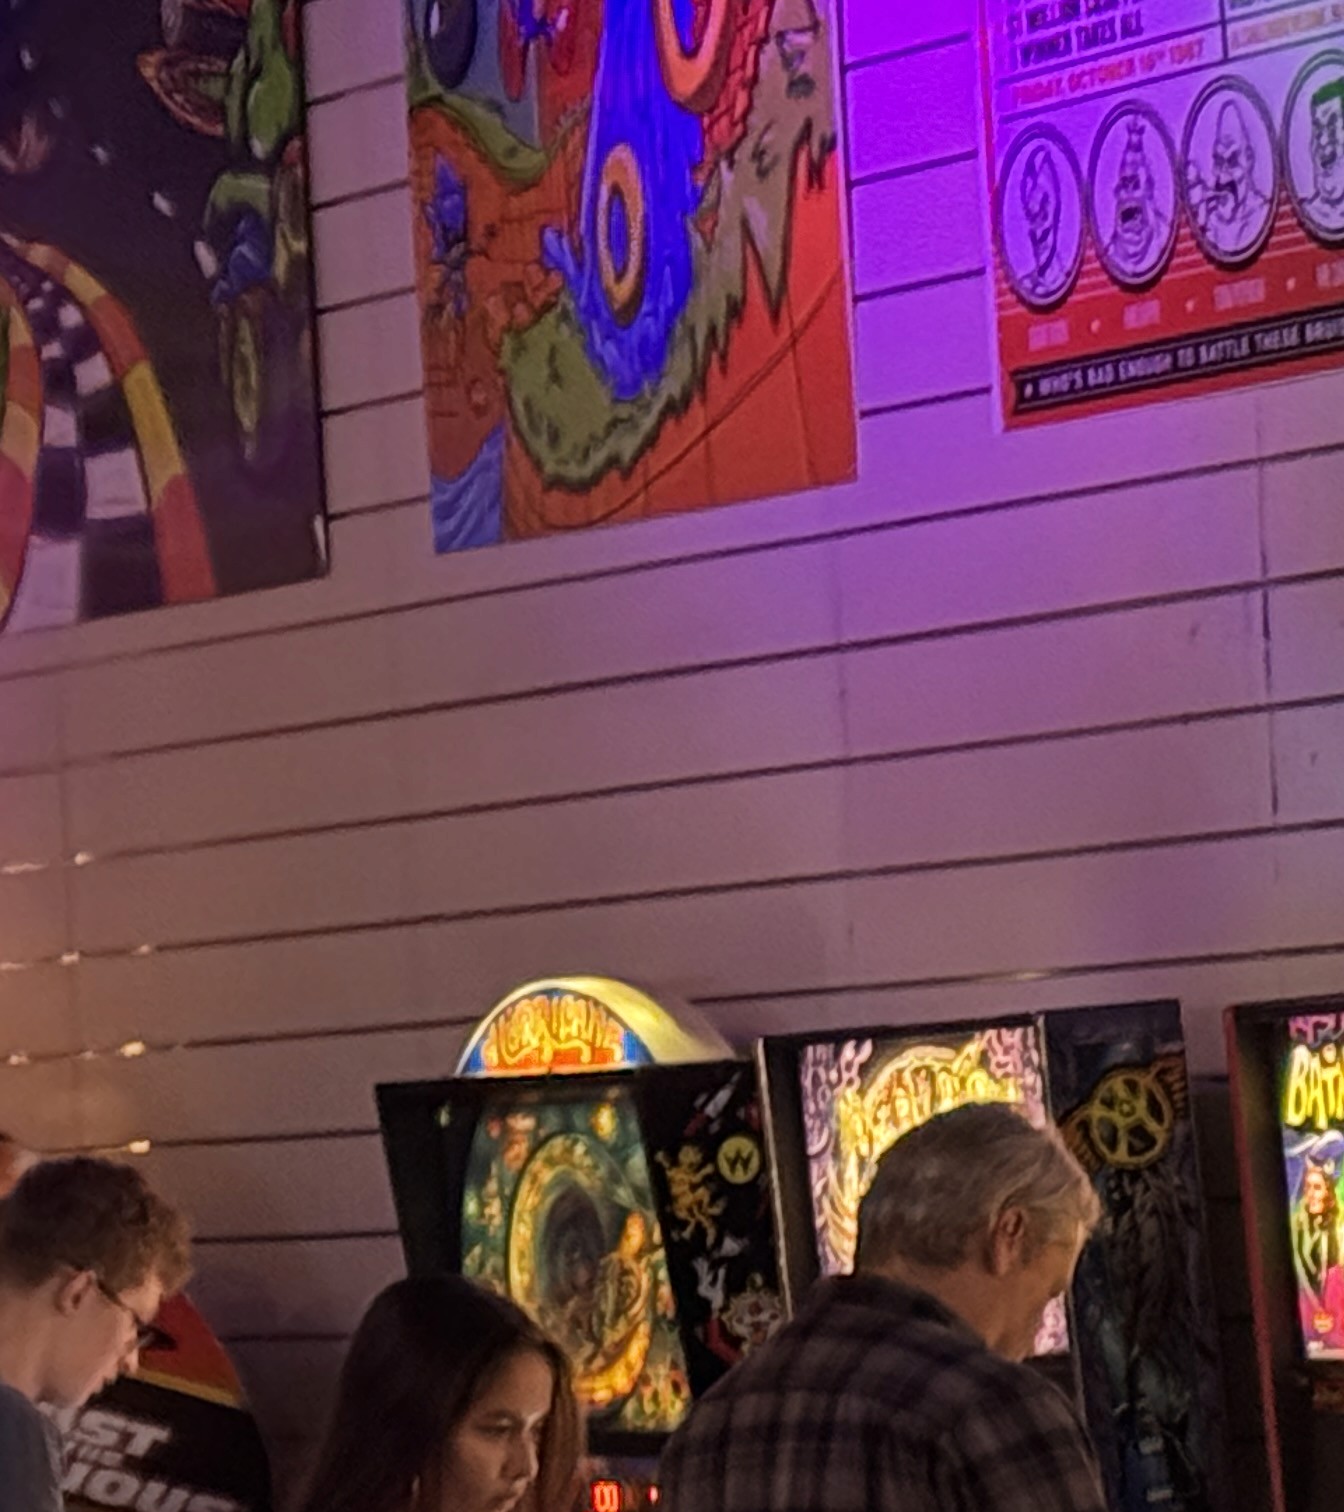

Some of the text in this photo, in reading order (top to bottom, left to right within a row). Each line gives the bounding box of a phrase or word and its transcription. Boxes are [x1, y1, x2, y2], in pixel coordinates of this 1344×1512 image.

[1038, 369, 1084, 397] WHO'S
[1087, 362, 1116, 387] BAD
[1200, 336, 1251, 364] BATTLE
